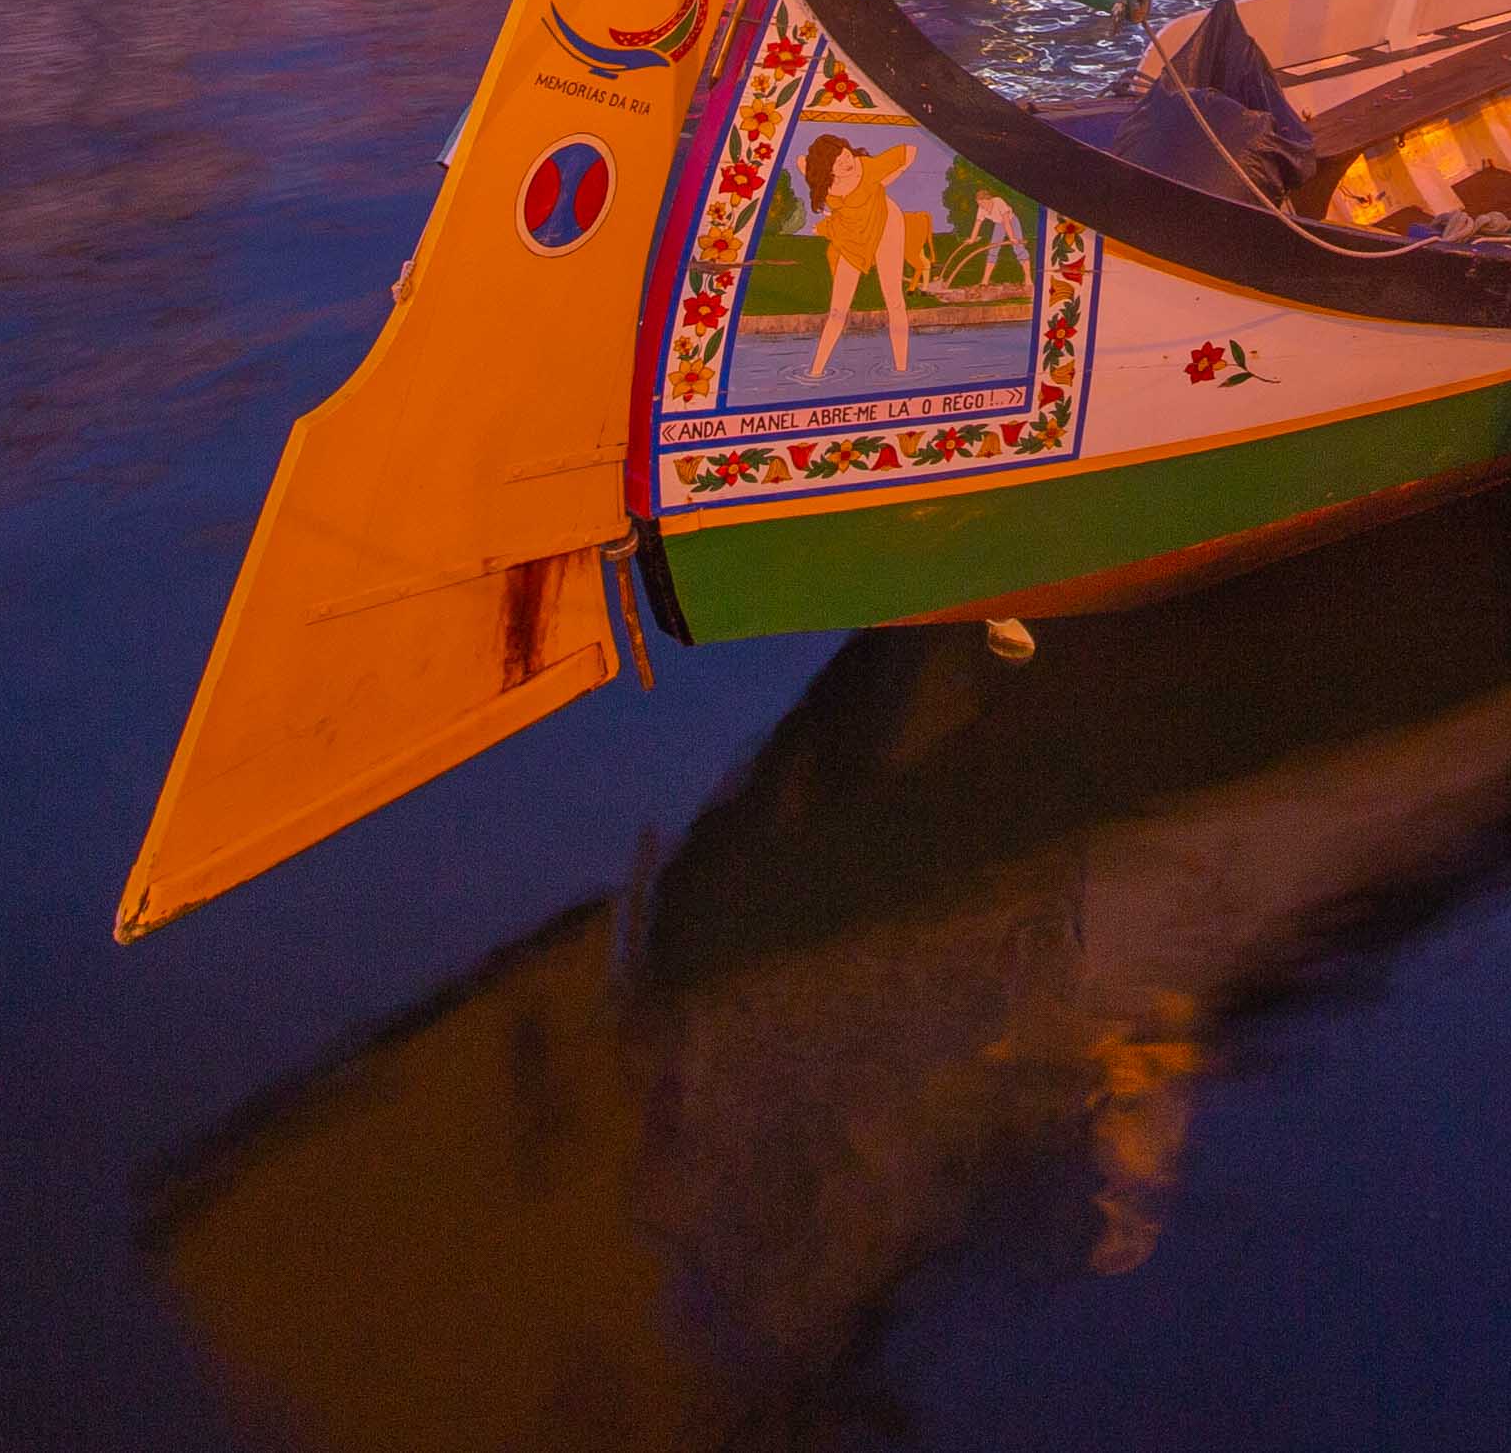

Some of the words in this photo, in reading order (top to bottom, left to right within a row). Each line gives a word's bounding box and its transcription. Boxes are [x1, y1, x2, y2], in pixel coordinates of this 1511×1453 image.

[629, 98, 651, 116] RIA
[740, 413, 800, 435] MANEL
[806, 404, 878, 427] ABRE-ME
[921, 398, 932, 415] O
